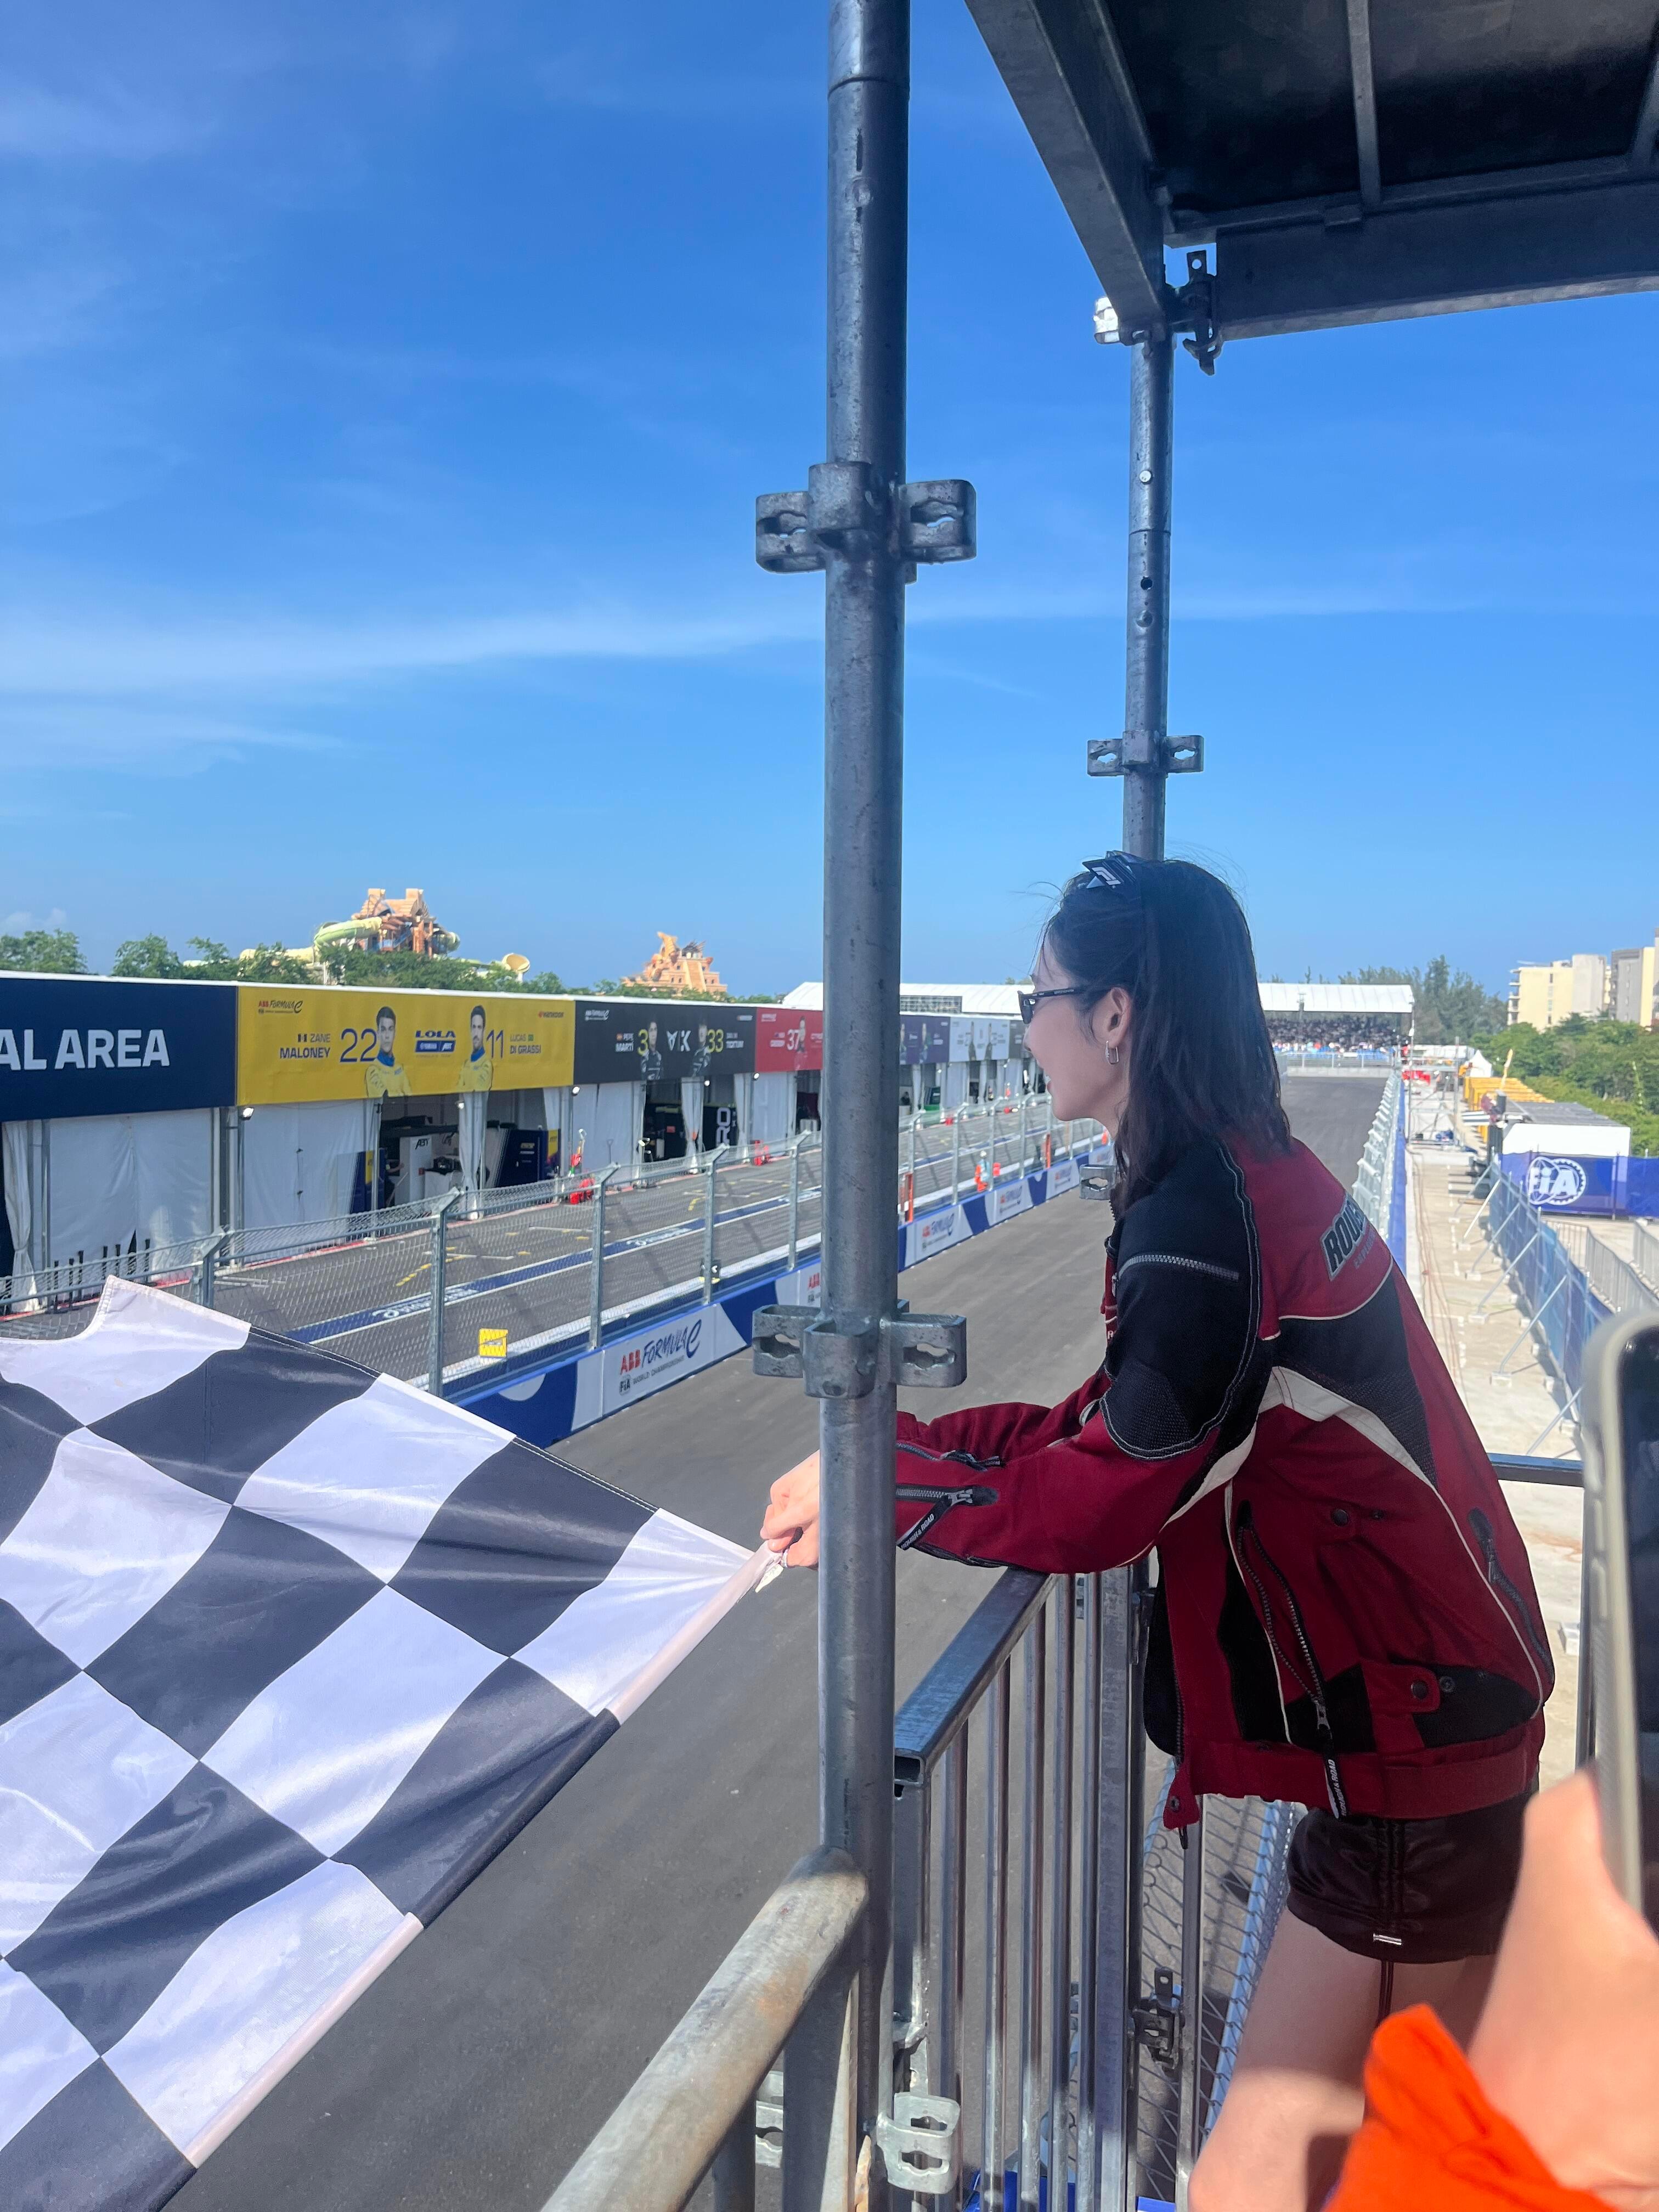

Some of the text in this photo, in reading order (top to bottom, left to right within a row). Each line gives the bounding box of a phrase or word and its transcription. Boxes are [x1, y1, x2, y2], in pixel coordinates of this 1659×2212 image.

[0, 1029, 170, 1070] AL AREA
[310, 1034, 331, 1043] ZANE
[340, 1028, 377, 1062] 22
[486, 1029, 504, 1059] 11
[510, 1045, 541, 1054] DI GRASSI
[707, 1029, 724, 1053] 33
[787, 1029, 800, 1051] 37
[280, 1047, 331, 1059] MALONEY
[620, 1349, 641, 1375] ABB
[642, 1325, 689, 1369] FORMULA
[633, 1372, 650, 1385] WORLD
[921, 1513, 935, 1531] ROAD
[1328, 1759, 1339, 1782] ROAD
